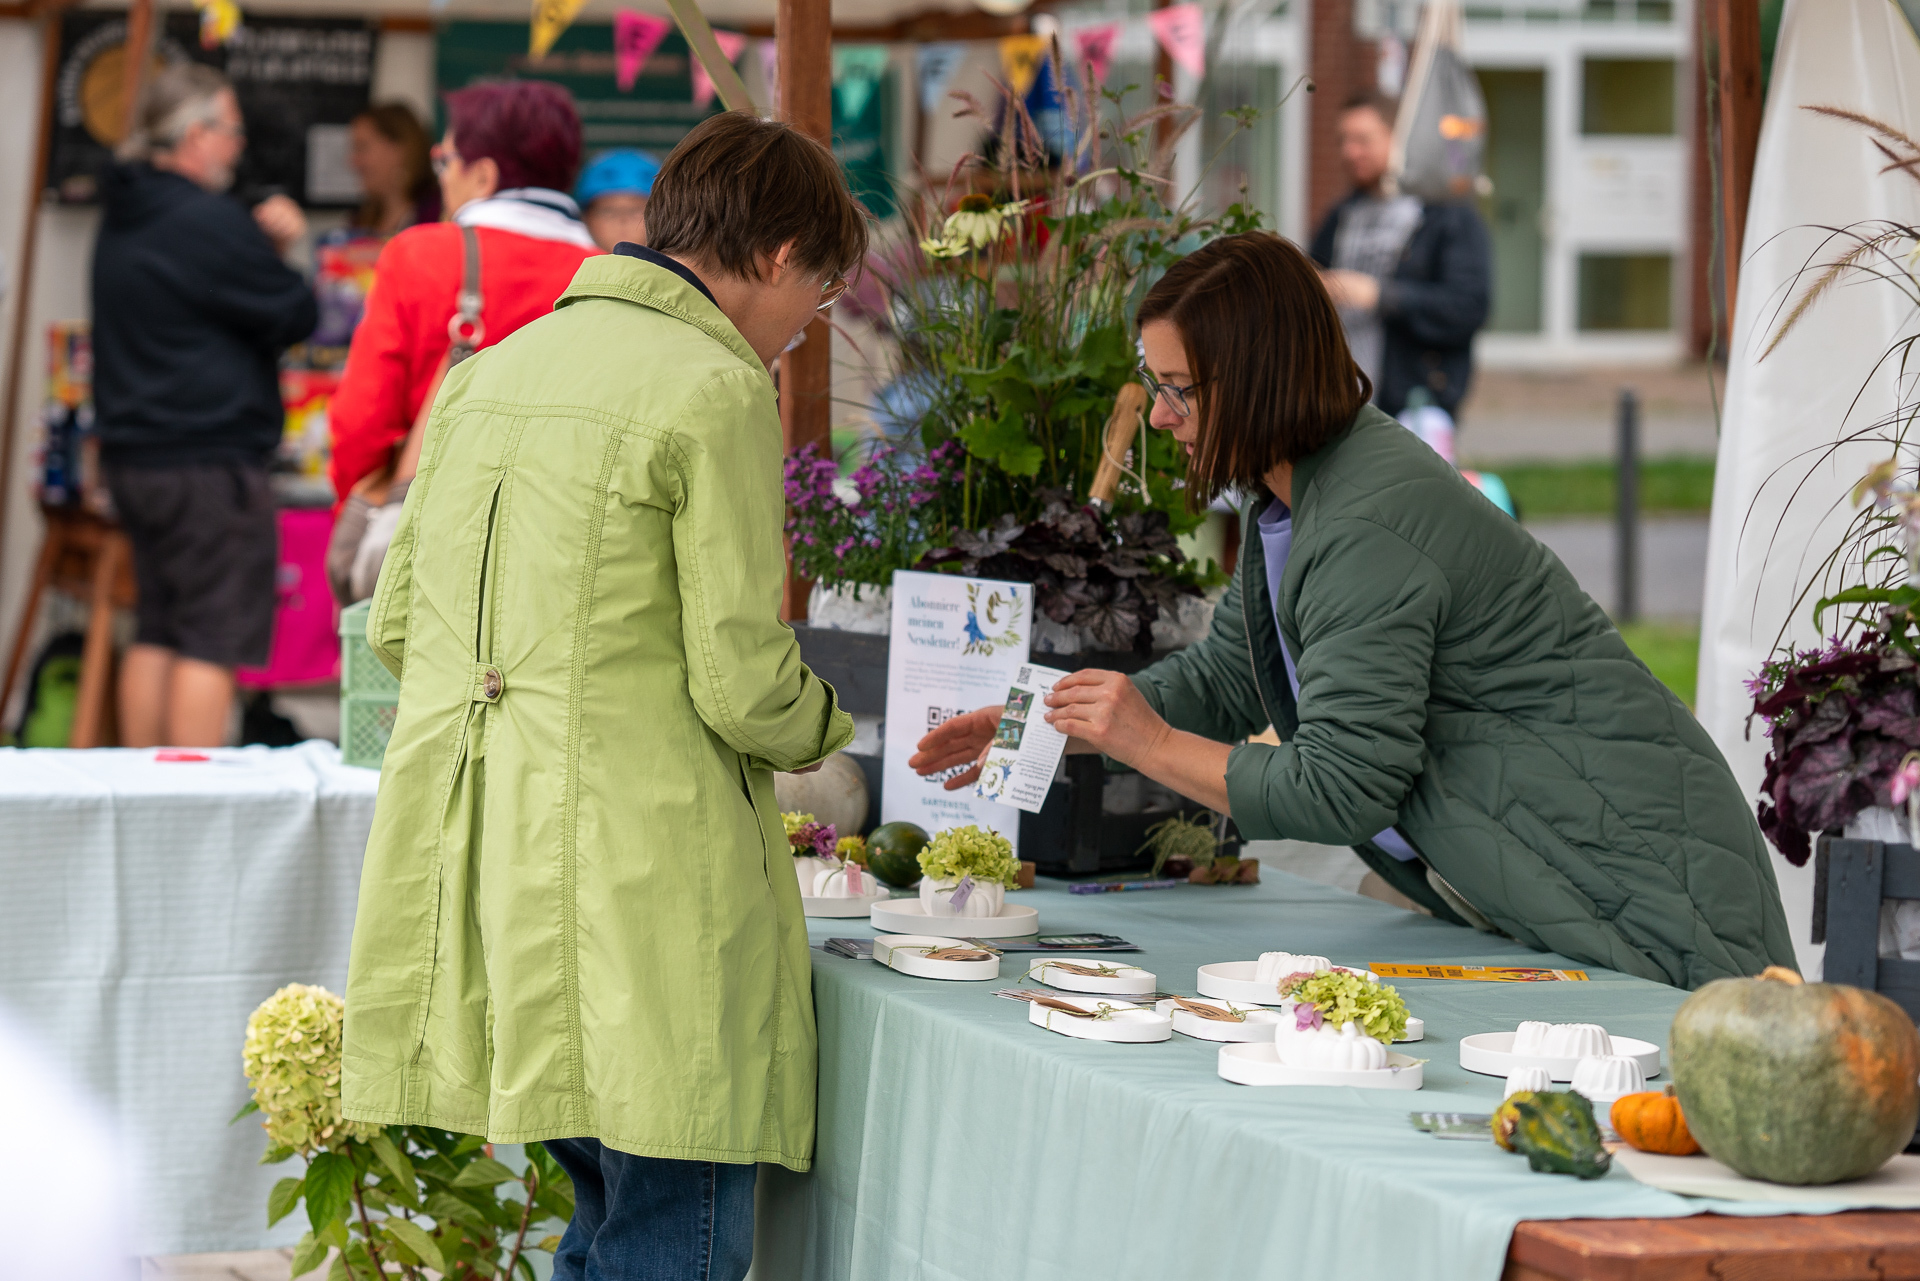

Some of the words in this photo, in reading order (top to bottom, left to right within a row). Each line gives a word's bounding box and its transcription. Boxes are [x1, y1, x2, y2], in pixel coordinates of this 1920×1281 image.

[909, 595, 961, 613] Abonniere
[907, 614, 944, 630] meinen
[907, 631, 961, 650] Newsletter!
[921, 797, 971, 811] GARTENSTIL
